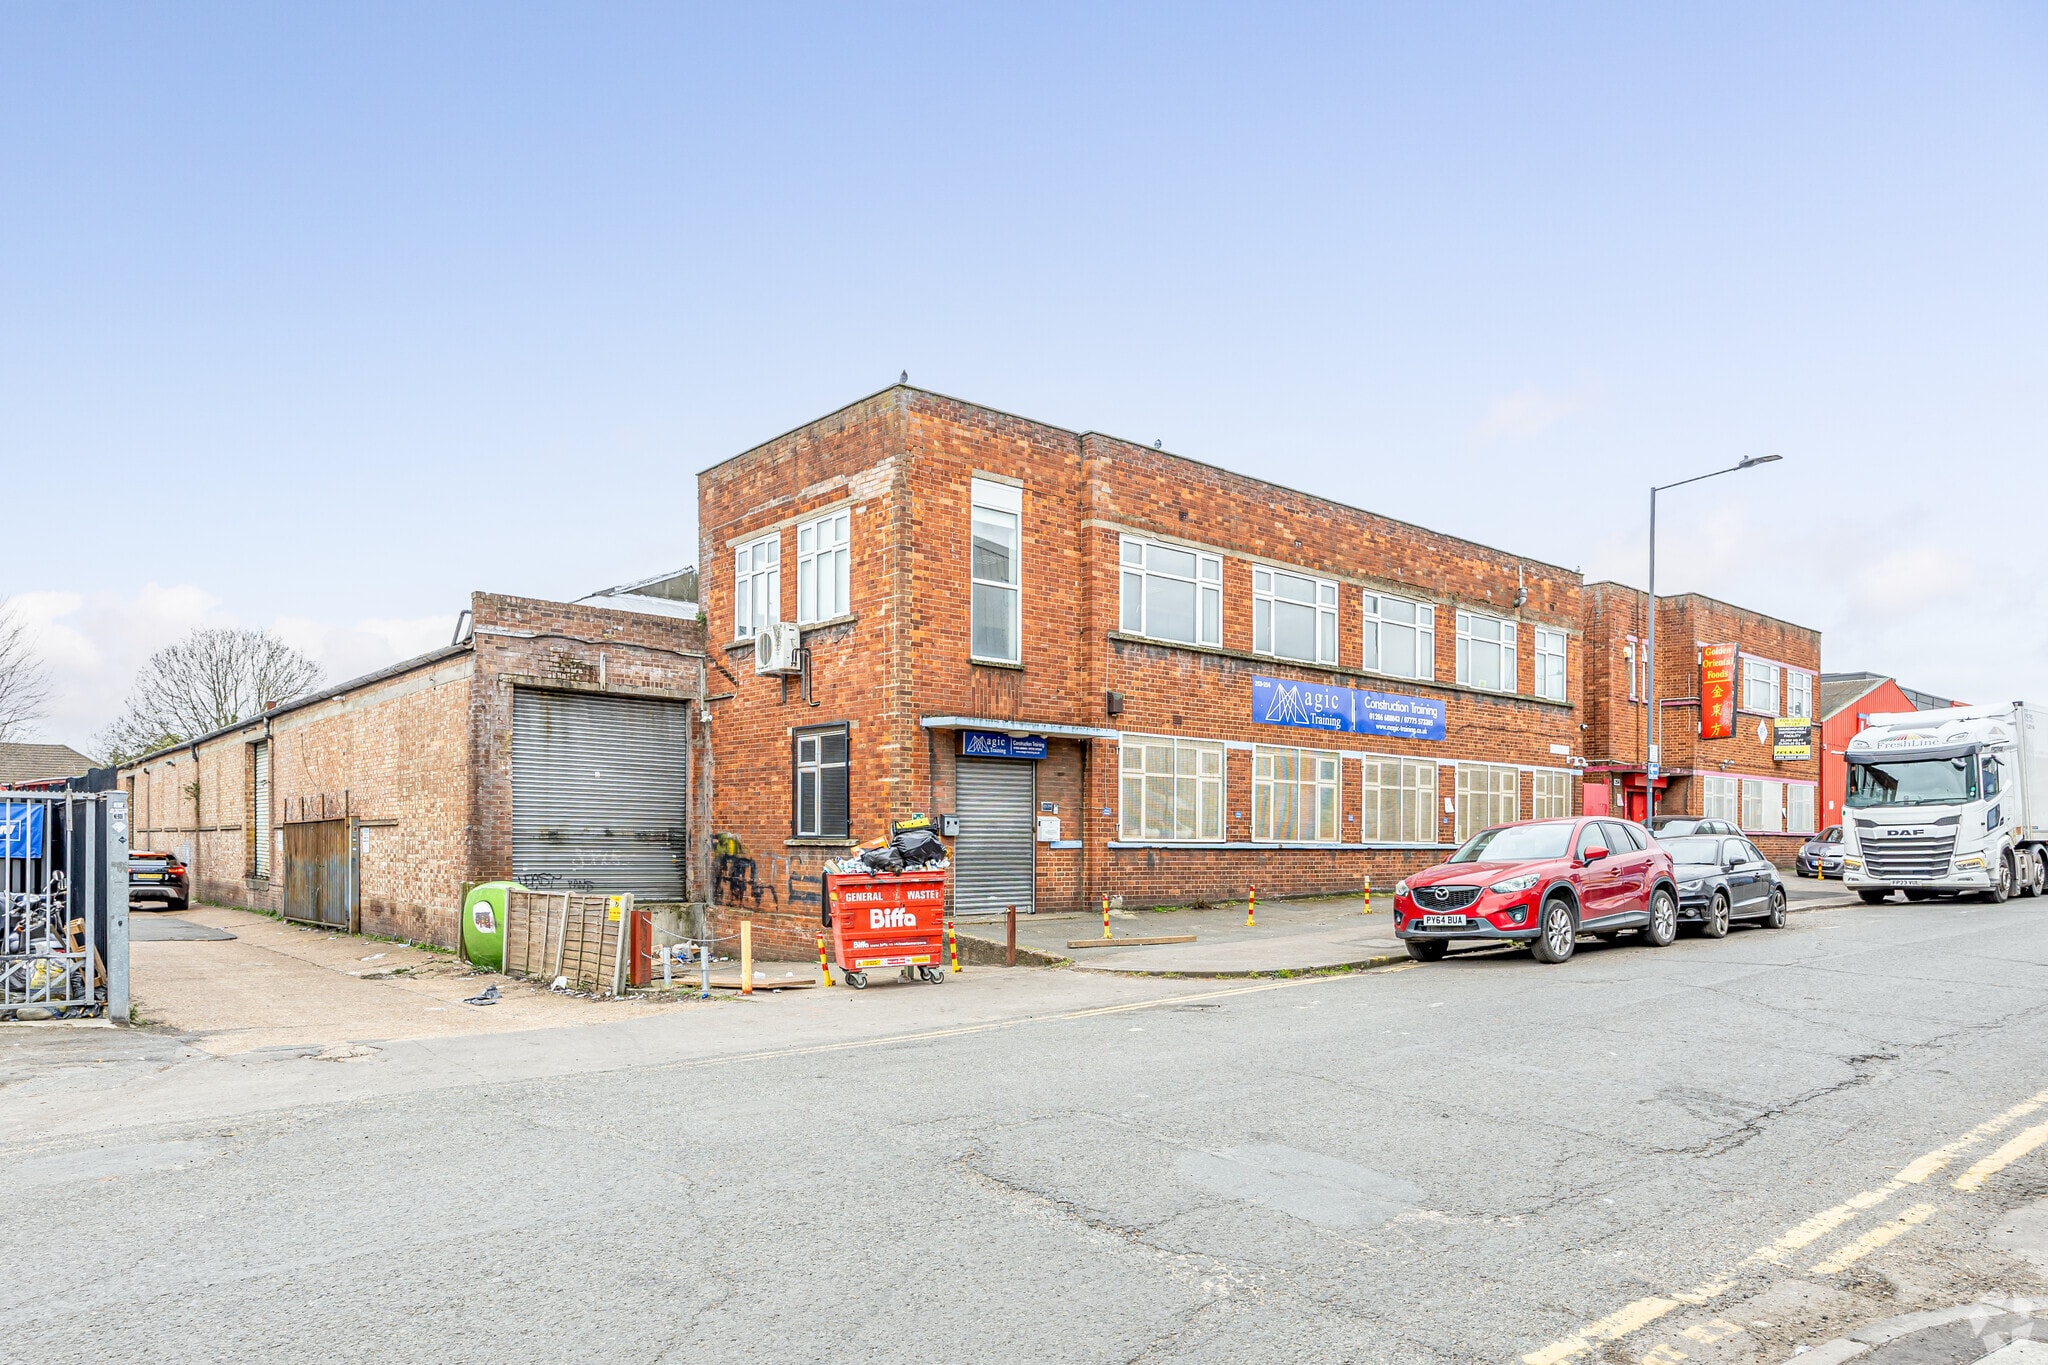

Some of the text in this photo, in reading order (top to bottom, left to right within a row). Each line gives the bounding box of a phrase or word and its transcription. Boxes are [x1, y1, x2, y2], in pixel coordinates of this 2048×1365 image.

[1705, 646, 1731, 656] Golden
[1702, 658, 1734, 668] Oriental
[1707, 669, 1728, 679] Foods
[1364, 696, 1438, 719] Construction Training
[1310, 712, 1341, 729] Training
[1877, 739, 1940, 750] FreshLine
[990, 746, 1006, 755] Training
[845, 891, 883, 902] GENERAL
[869, 907, 917, 929] Biffa
[1426, 916, 1463, 924] PY64 BUA
[853, 941, 870, 949] Biffa
